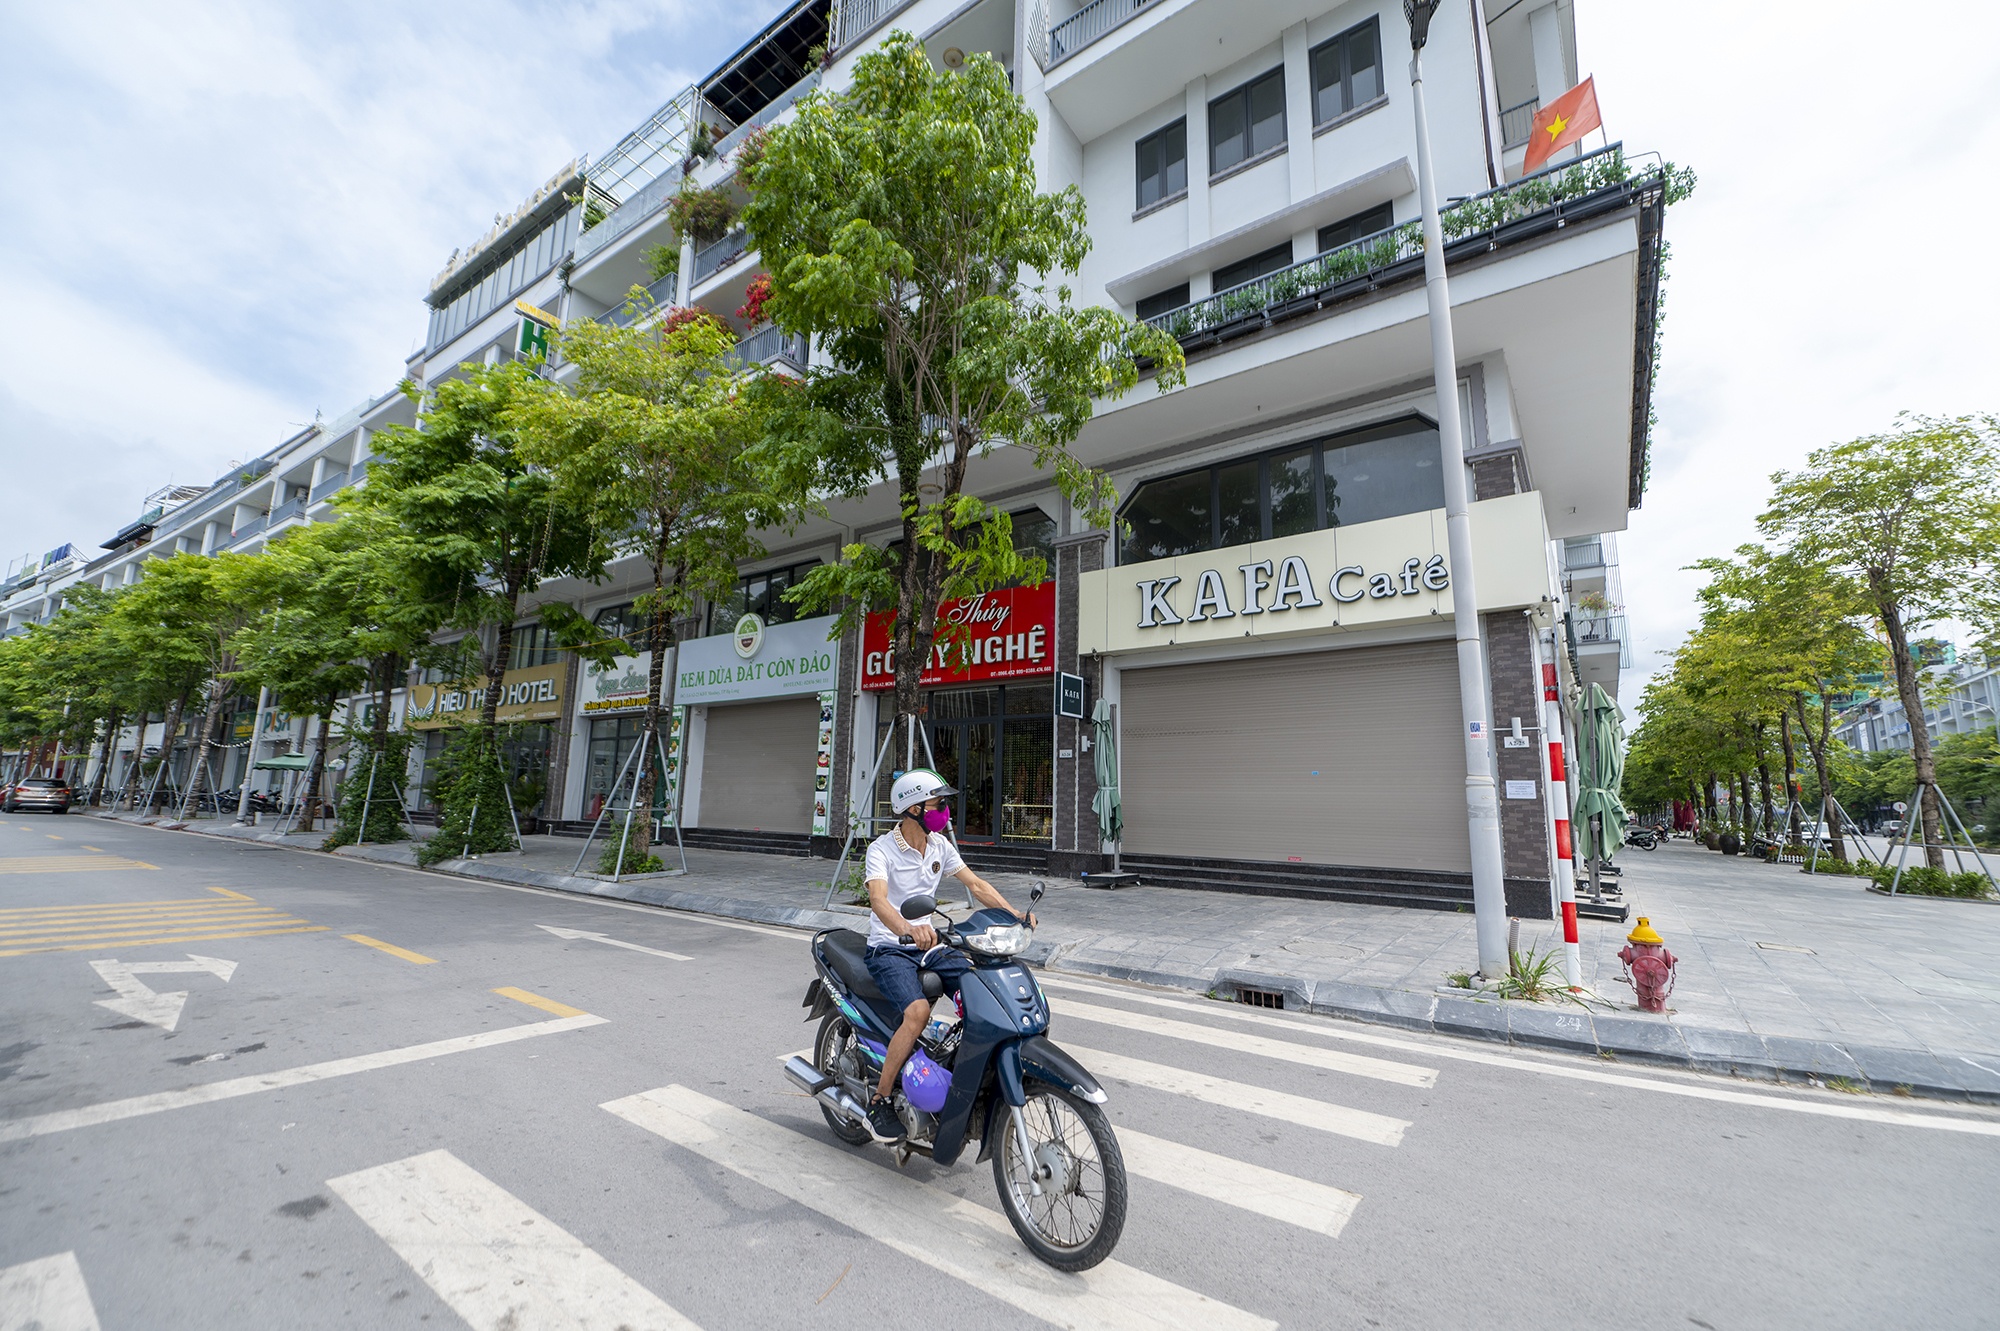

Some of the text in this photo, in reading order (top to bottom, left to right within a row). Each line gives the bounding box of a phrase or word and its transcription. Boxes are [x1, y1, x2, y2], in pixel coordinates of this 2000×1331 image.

[1136, 554, 1450, 629] KAFA Café
[961, 623, 1047, 665] NGHỆ
[680, 650, 831, 688] KEM DỪA ĐẤT CÔN ĐẢO
[470, 685, 507, 710] THO
[508, 679, 559, 705] HOTEL
